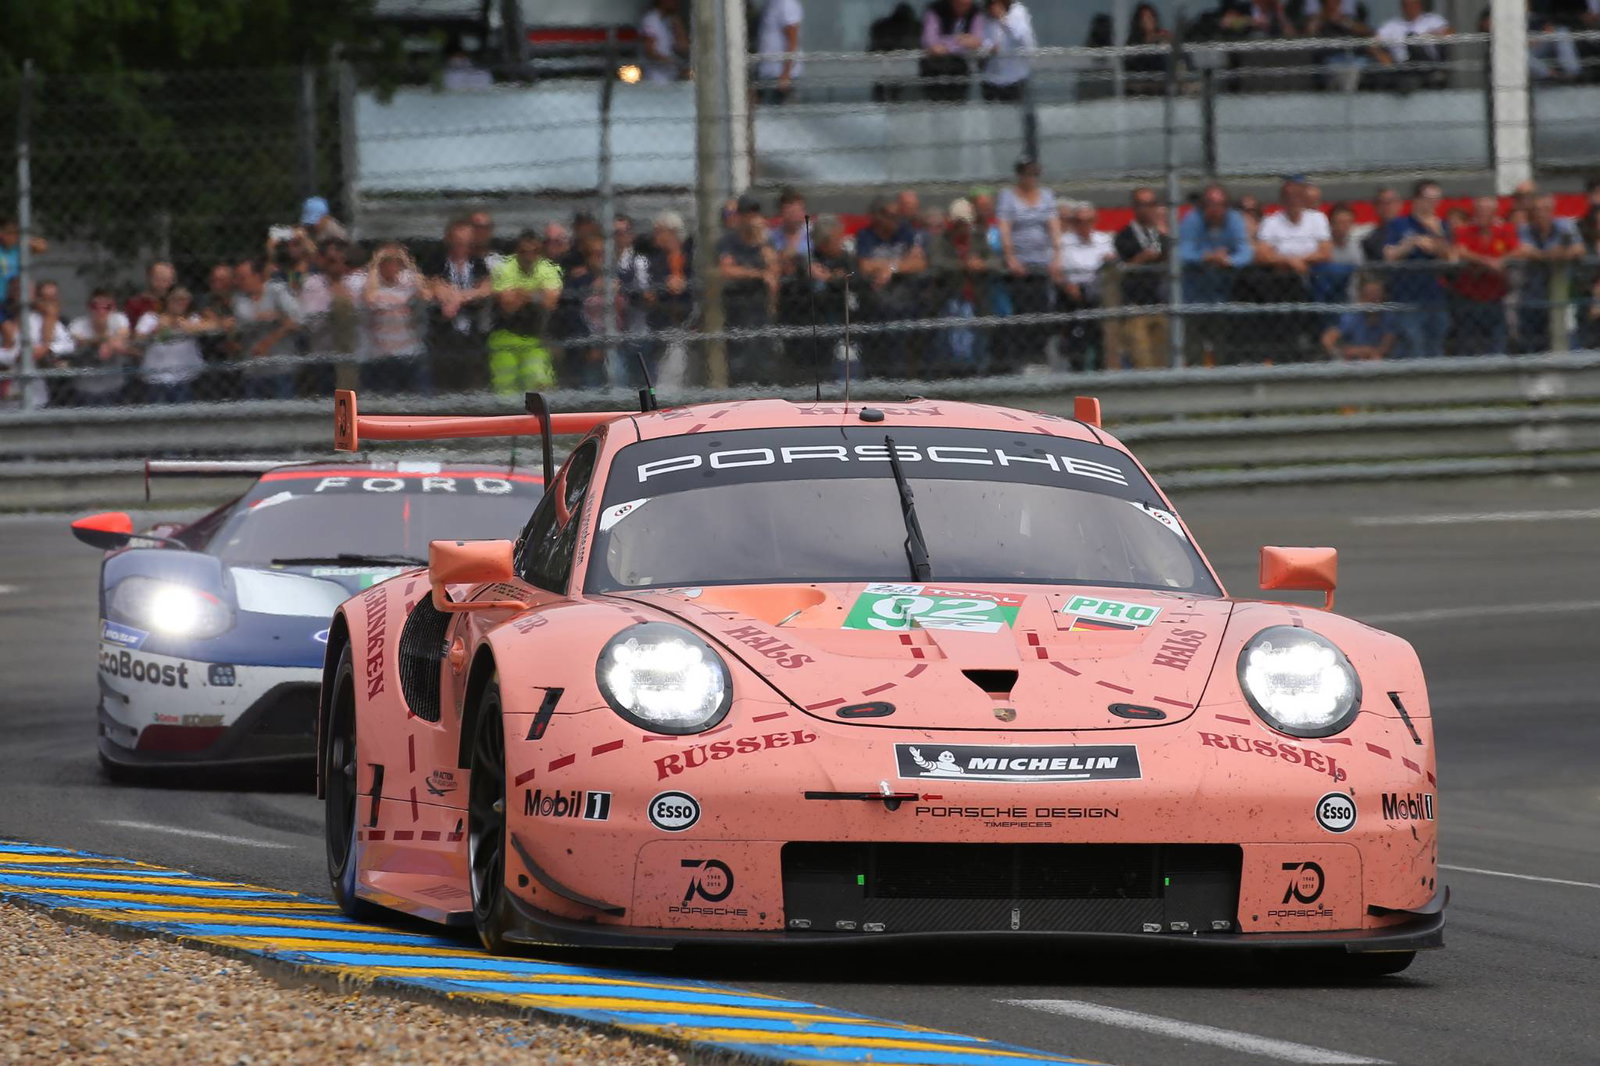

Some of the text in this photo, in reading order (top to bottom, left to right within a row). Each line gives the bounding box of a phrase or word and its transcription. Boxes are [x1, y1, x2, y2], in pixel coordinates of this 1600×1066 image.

[637, 445, 1129, 487] PORSCHE
[314, 476, 513, 495] FORD
[928, 588, 1019, 603] TOTAL
[1069, 597, 1155, 621] PRO
[867, 595, 998, 631] 92
[362, 587, 388, 702] CHINKEN
[722, 625, 816, 669] HALS
[1152, 628, 1208, 671] HALS
[99, 643, 189, 690] coBoost
[653, 729, 817, 782] RÜSSEL
[967, 756, 1119, 771] MICHELIN
[1197, 731, 1347, 782] RÜSSEL
[524, 789, 583, 818] Mobil
[656, 801, 693, 819] Esso
[915, 806, 1119, 819] PORSCHE DESIGN
[1322, 802, 1351, 820] Esso
[1381, 793, 1425, 821] Mobil
[680, 858, 735, 903] 70
[1281, 861, 1325, 905] 70
[668, 905, 749, 917] PORSCHE
[1267, 908, 1334, 918] PORSCHE
